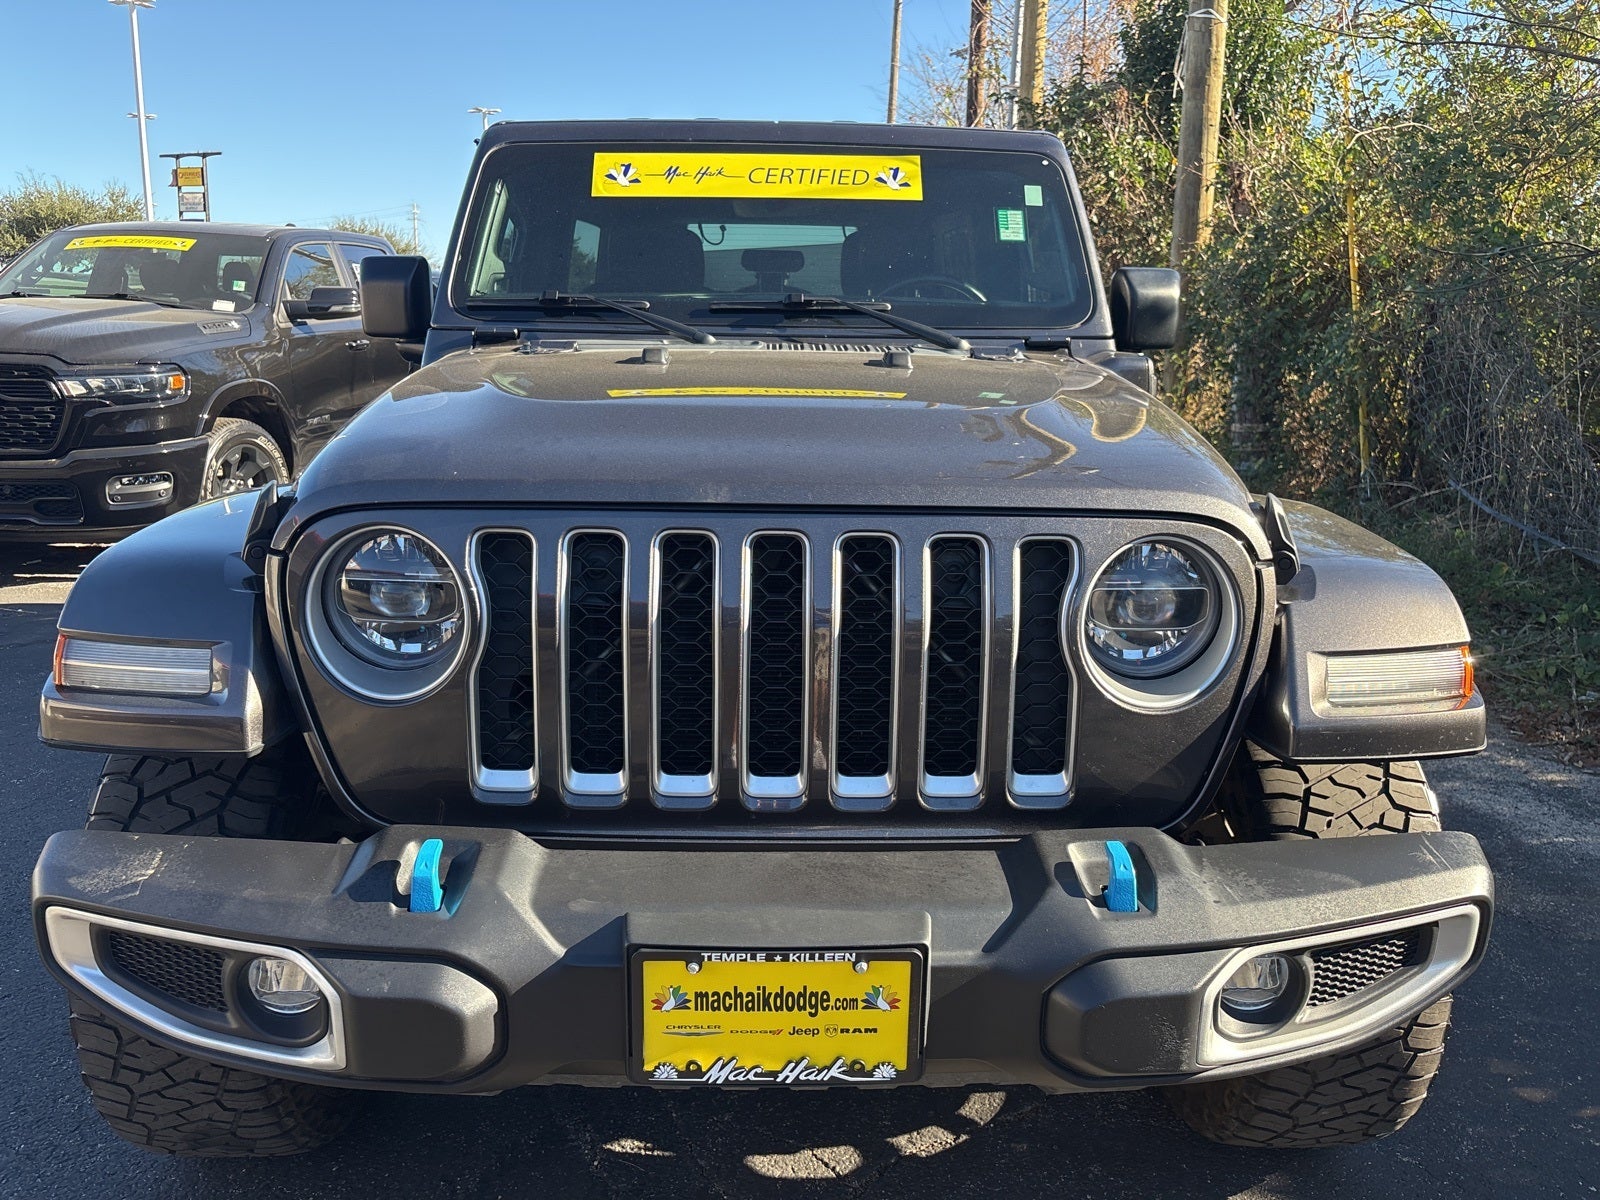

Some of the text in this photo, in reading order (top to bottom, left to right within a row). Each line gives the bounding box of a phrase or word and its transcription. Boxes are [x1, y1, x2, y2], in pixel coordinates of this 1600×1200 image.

[660, 165, 870, 186] Mac Haik CERTIFIED
[701, 952, 856, 962] TEMPLE KILLEEN
[693, 985, 859, 1017] machaikdodge.com
[787, 1025, 821, 1038] Jeep
[839, 1027, 879, 1035] RAM
[701, 1057, 852, 1084] Mac Haik
